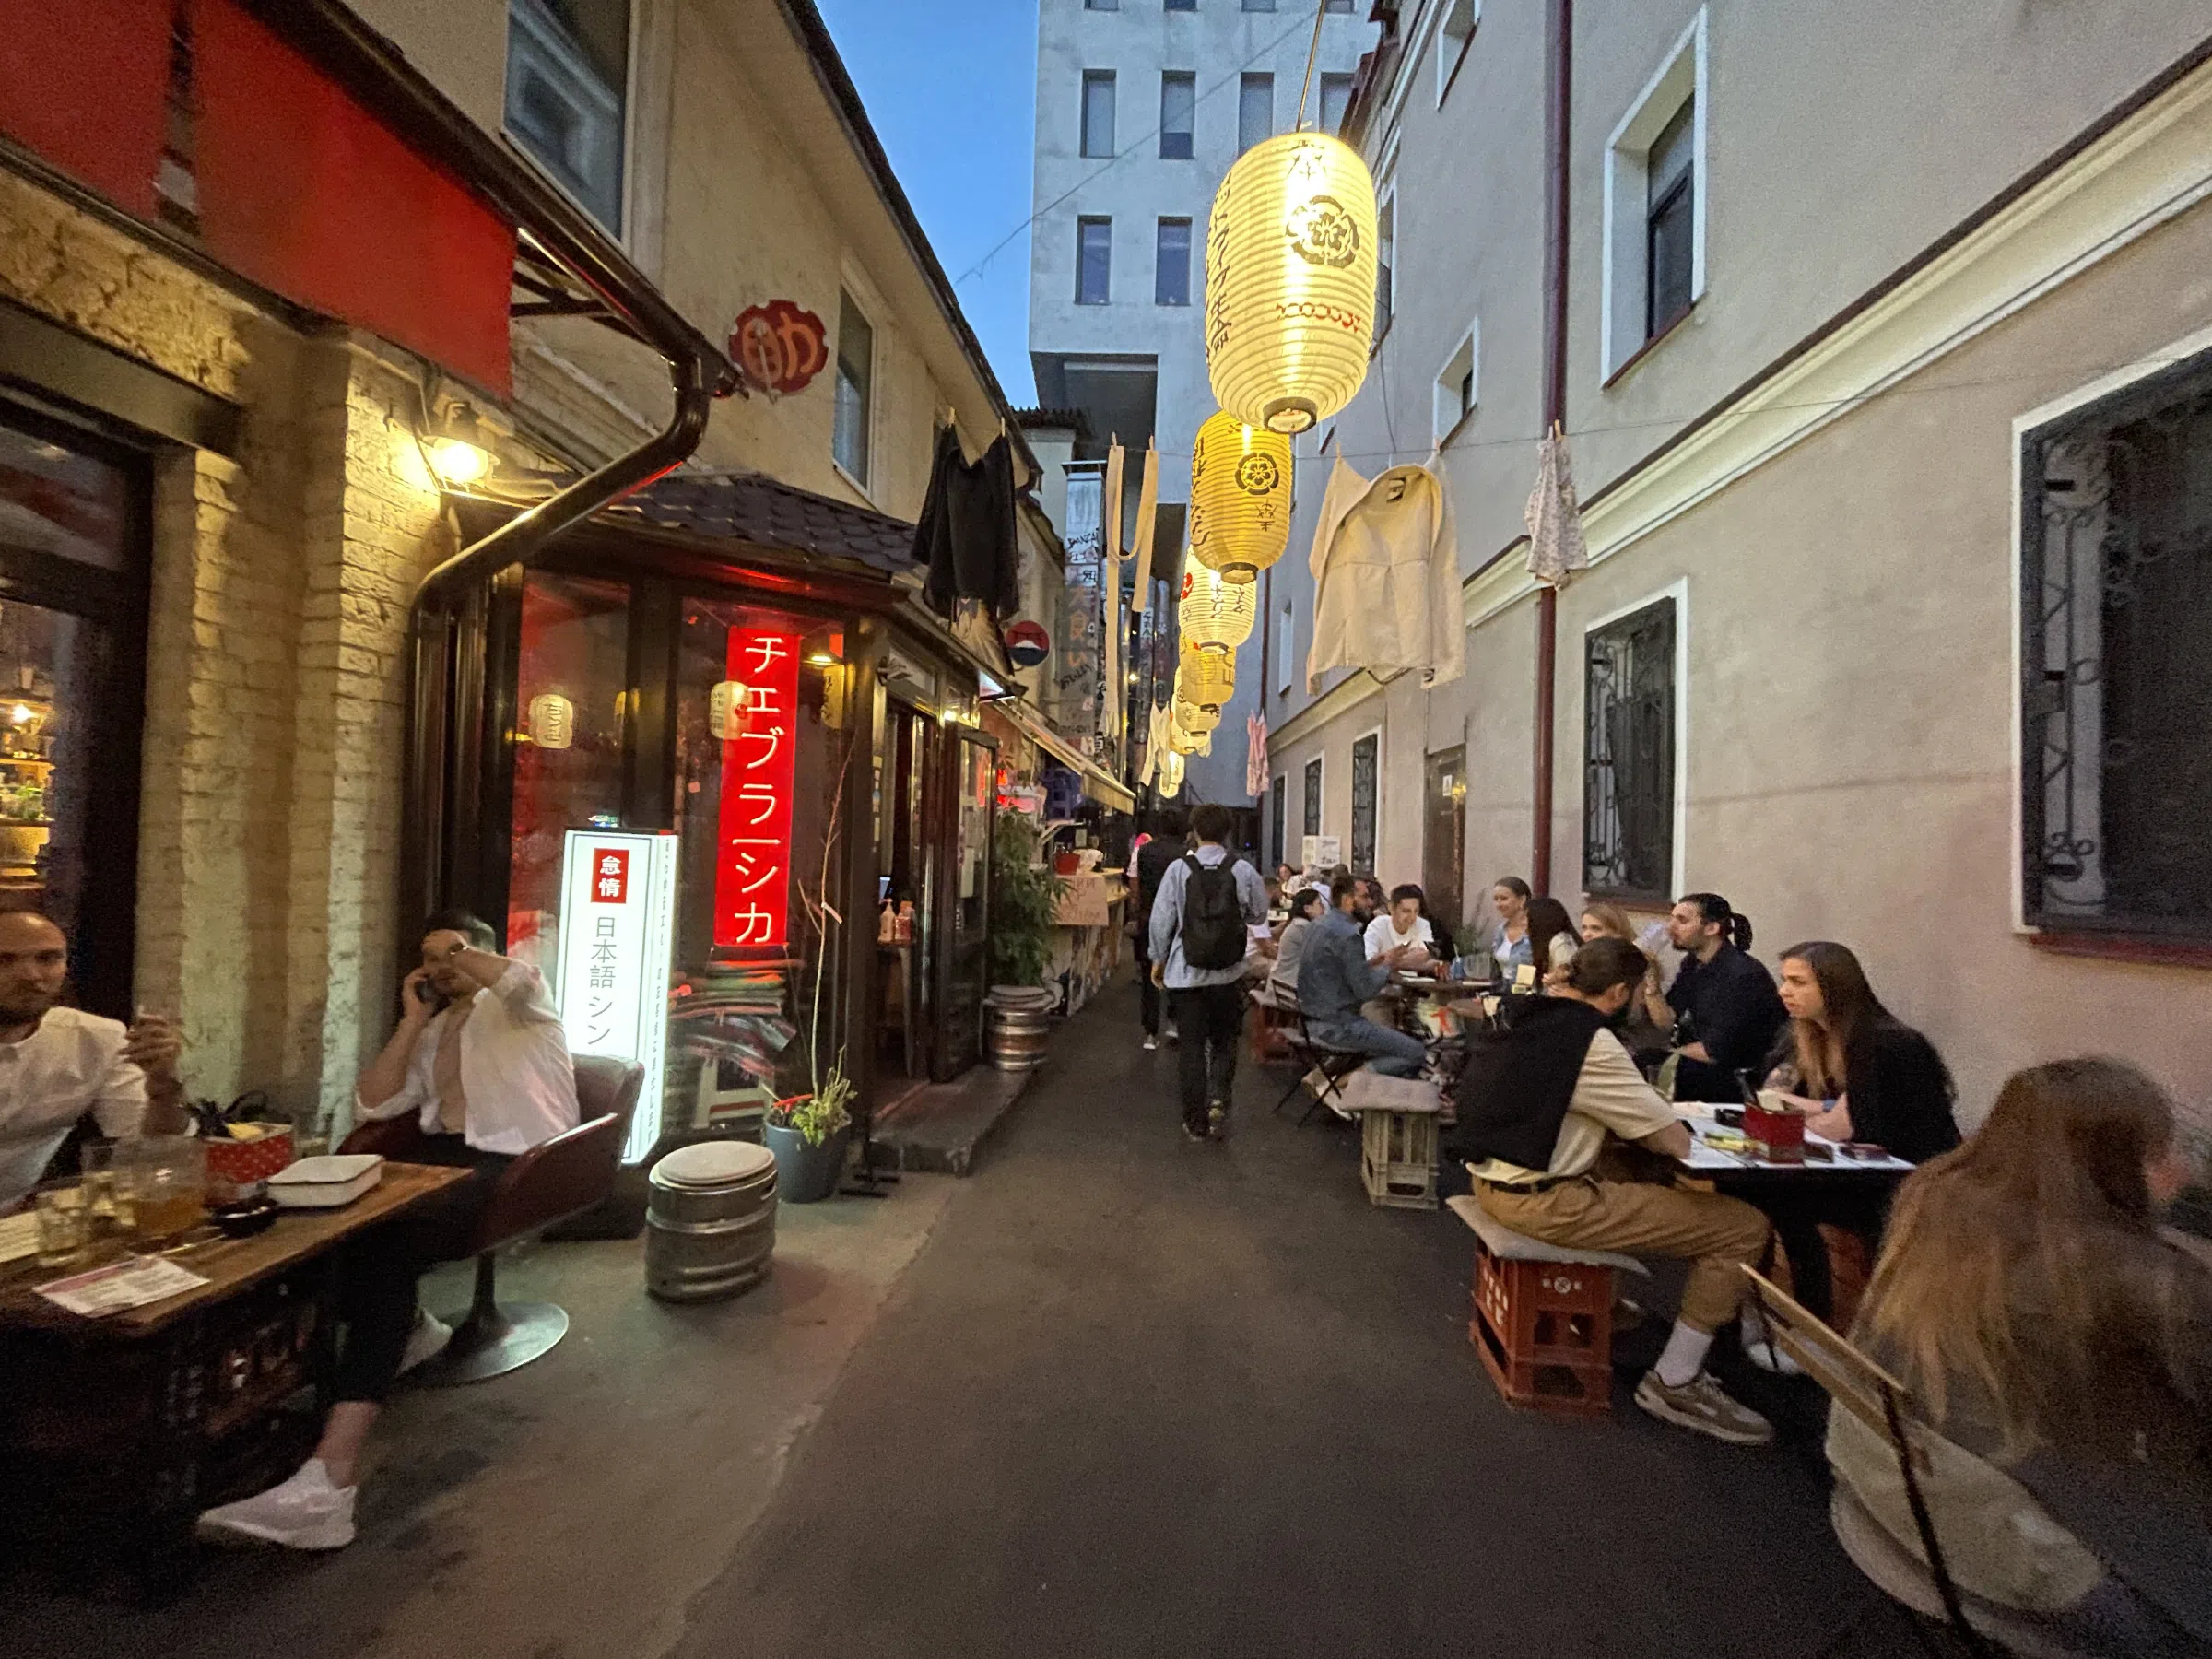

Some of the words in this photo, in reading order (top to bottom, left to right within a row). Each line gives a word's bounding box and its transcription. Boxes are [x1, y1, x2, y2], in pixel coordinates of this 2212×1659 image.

[731, 636, 789, 944] チェブラーシカ
[588, 916, 618, 1053] 日本語シン
